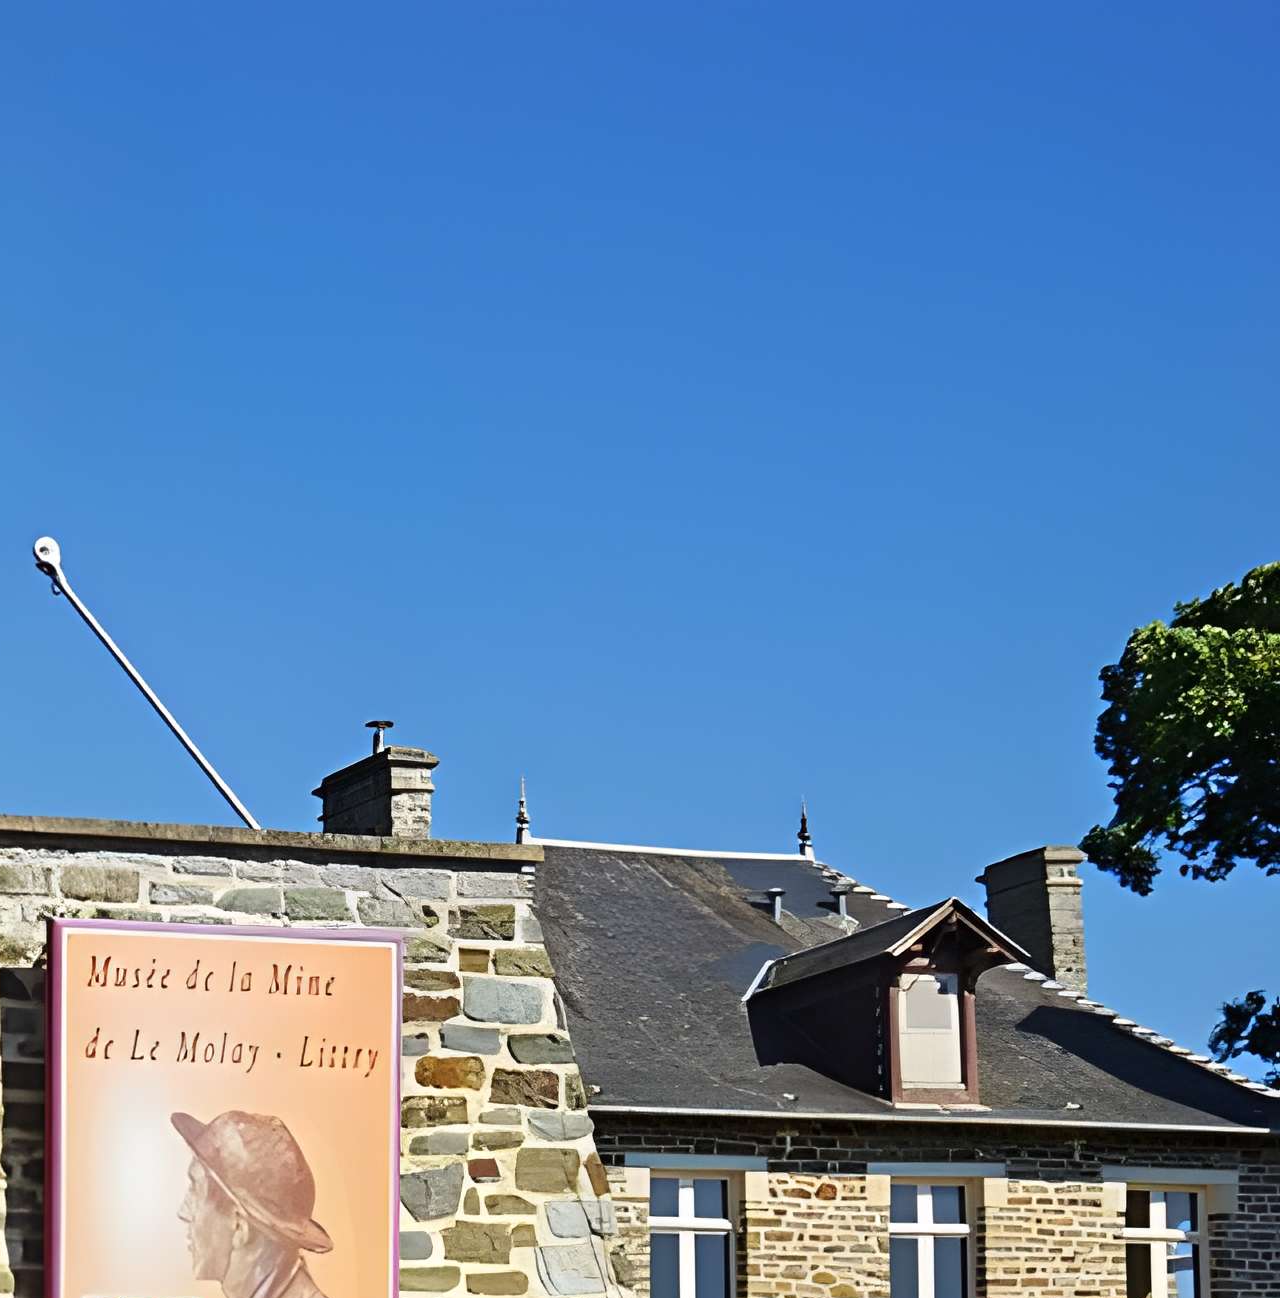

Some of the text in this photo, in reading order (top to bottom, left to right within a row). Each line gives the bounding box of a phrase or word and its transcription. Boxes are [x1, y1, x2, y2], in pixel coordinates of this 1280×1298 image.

[185, 959, 214, 992] de
[228, 960, 253, 993] la
[268, 963, 335, 997] Mine
[85, 1026, 114, 1060] de
[130, 1028, 160, 1061] Le
[176, 1031, 259, 1074] Molay
